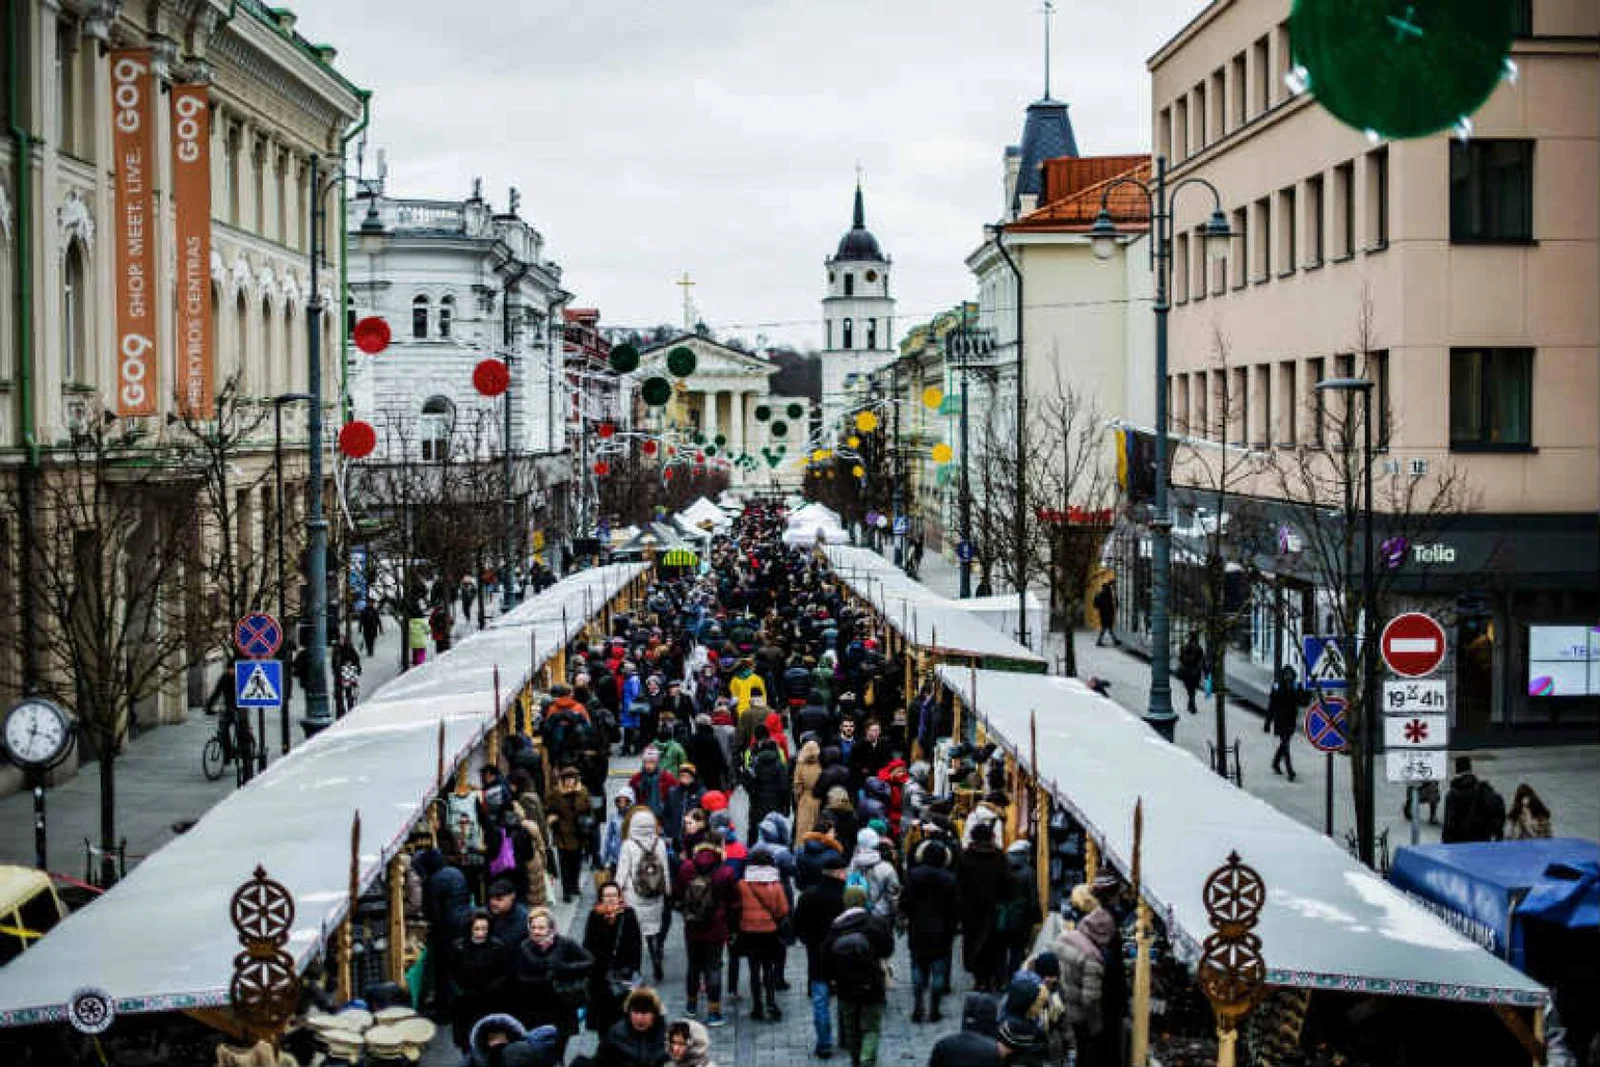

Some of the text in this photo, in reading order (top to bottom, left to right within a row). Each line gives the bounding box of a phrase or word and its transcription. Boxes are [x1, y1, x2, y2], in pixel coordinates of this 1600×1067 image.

[114, 58, 147, 133] GO9
[176, 94, 206, 163] GO9
[121, 333, 153, 407] GO9
